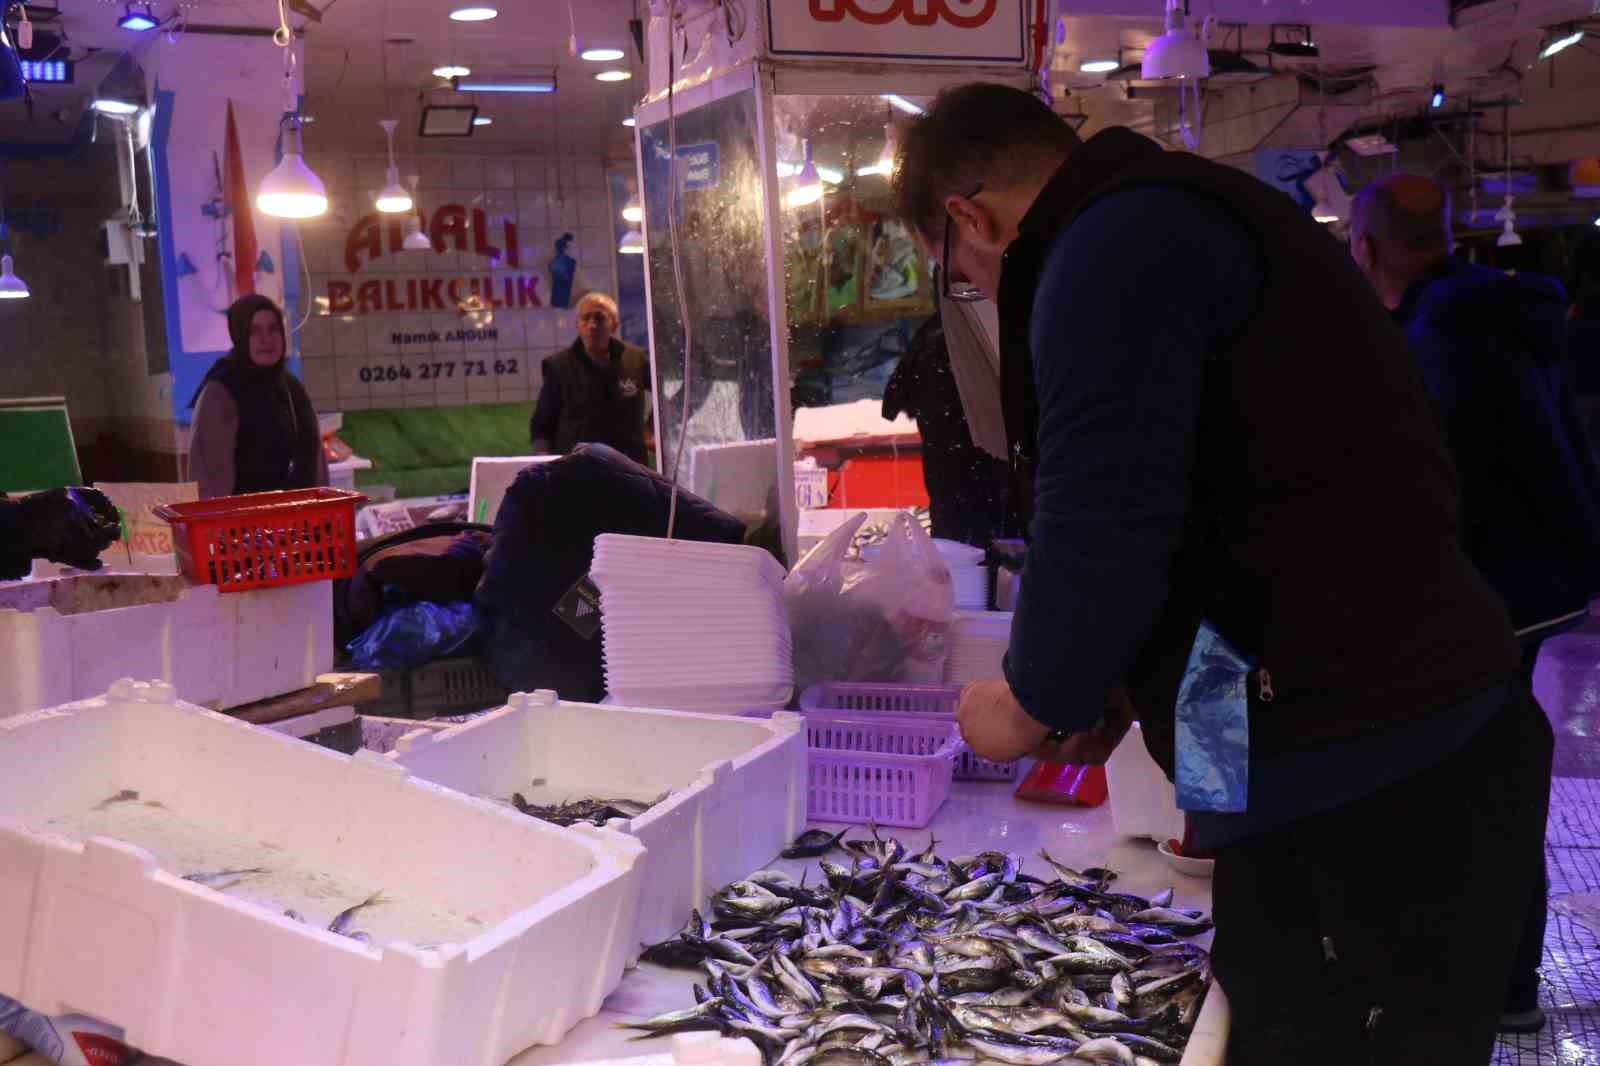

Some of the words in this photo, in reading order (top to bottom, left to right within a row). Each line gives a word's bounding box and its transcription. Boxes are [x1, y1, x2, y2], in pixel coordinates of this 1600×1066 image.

[360, 365, 412, 383] 0264
[418, 361, 456, 379] 277
[463, 360, 488, 376] 71
[494, 358, 518, 375] 62
